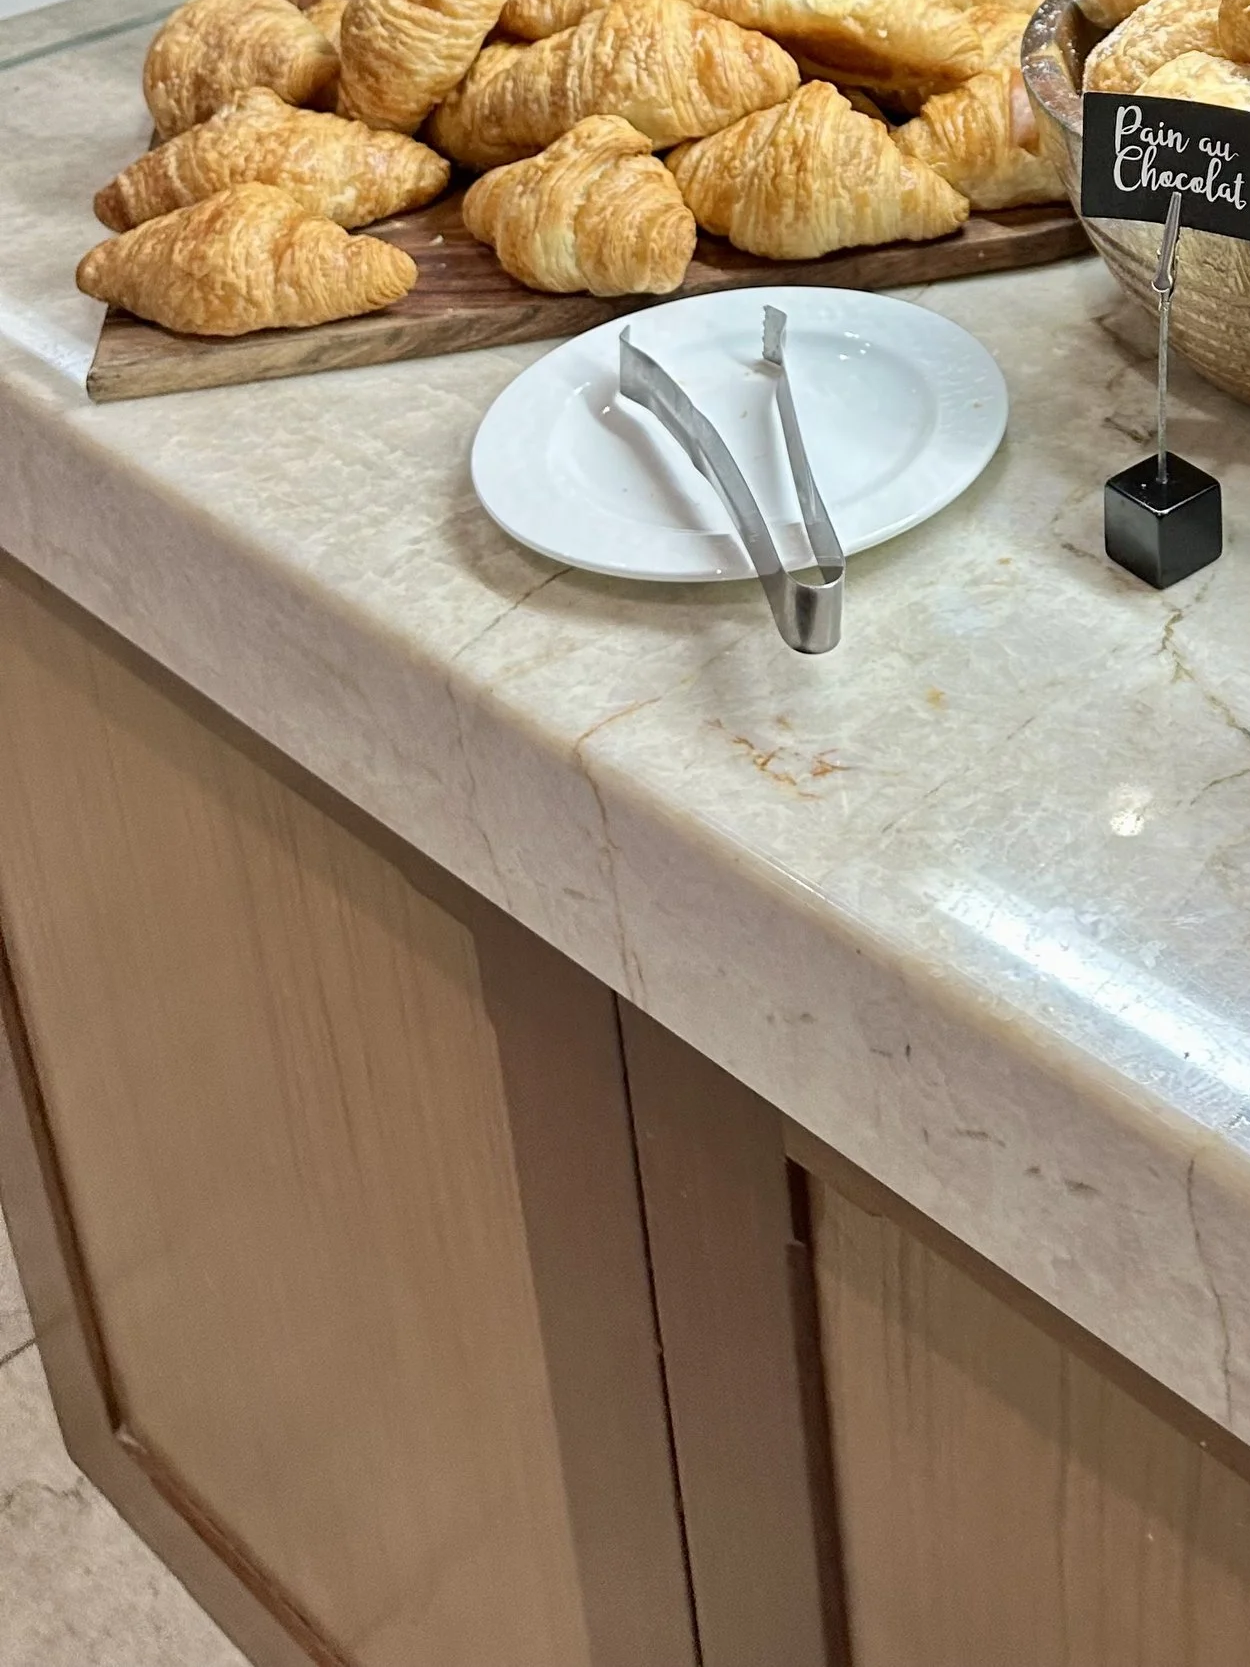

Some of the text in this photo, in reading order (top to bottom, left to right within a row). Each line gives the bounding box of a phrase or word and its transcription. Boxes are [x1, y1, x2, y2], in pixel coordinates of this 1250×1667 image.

[1114, 105, 1239, 162] Pain au
[1113, 145, 1247, 211] Chocolat
